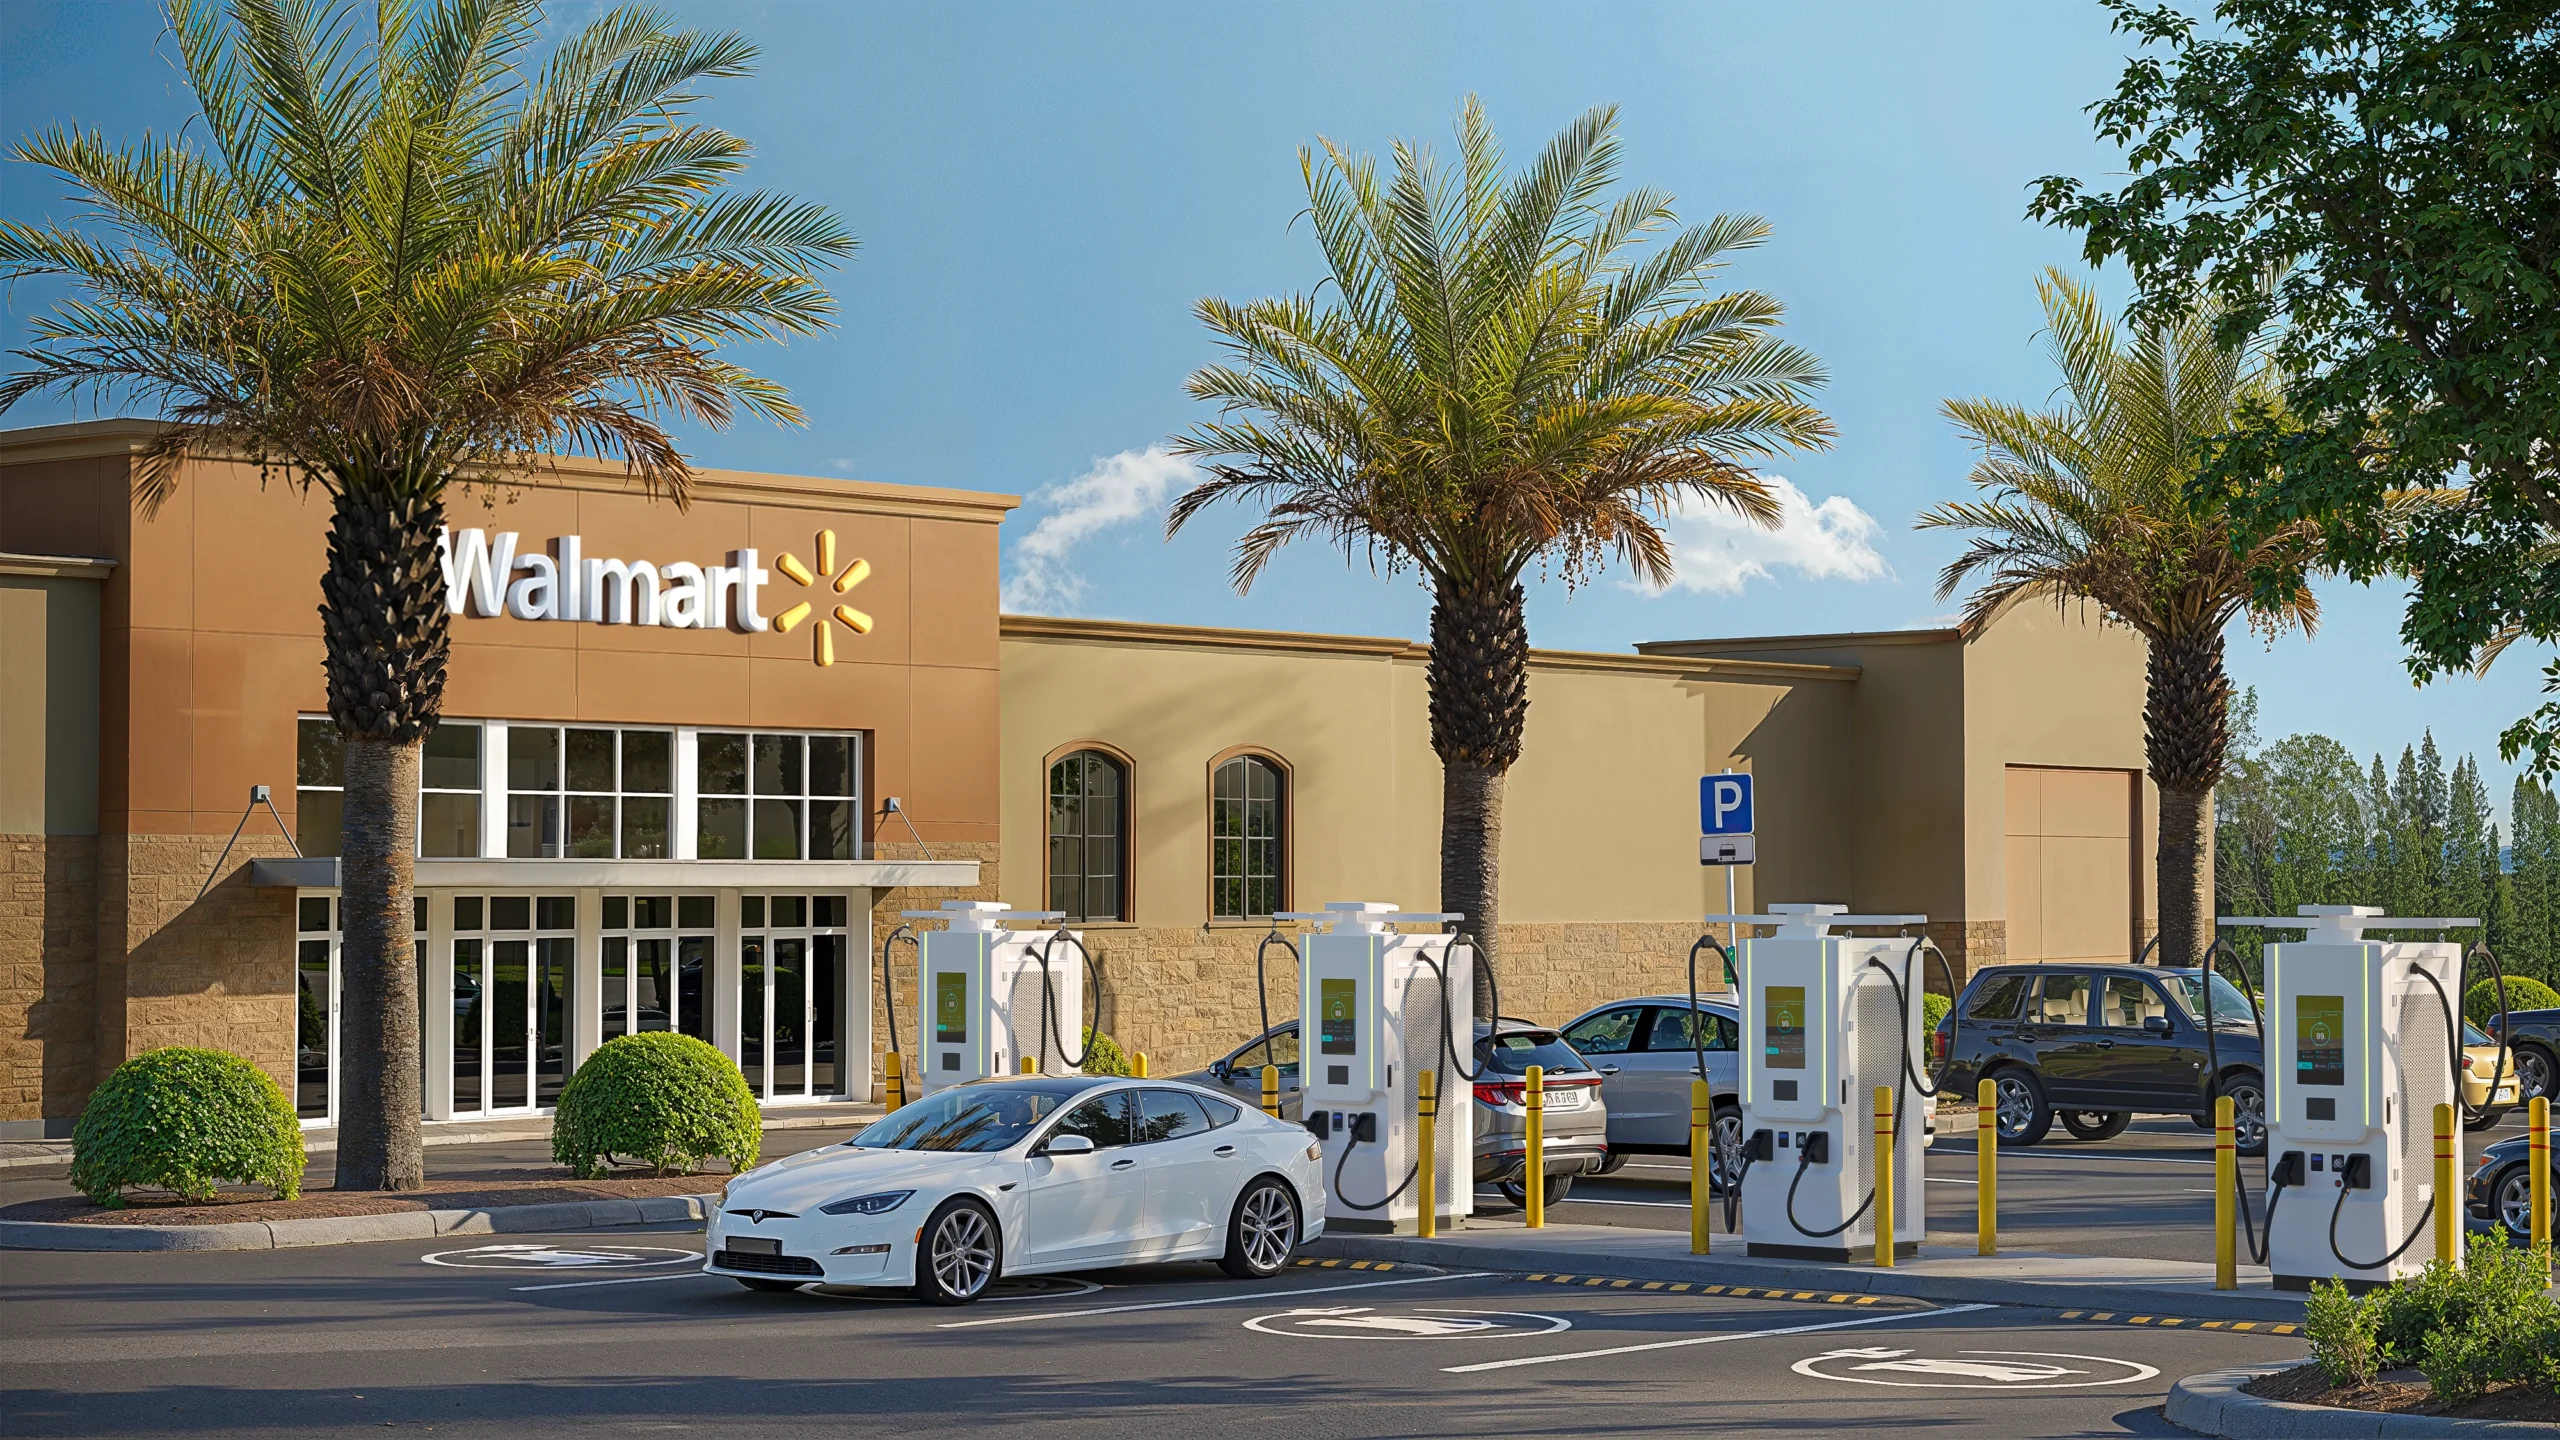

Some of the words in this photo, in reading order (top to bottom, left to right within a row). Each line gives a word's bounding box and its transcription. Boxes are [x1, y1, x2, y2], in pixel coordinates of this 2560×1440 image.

[437, 525, 769, 633] Walmart
[1714, 781, 1742, 828] P
[2316, 1032, 2325, 1040] 99
